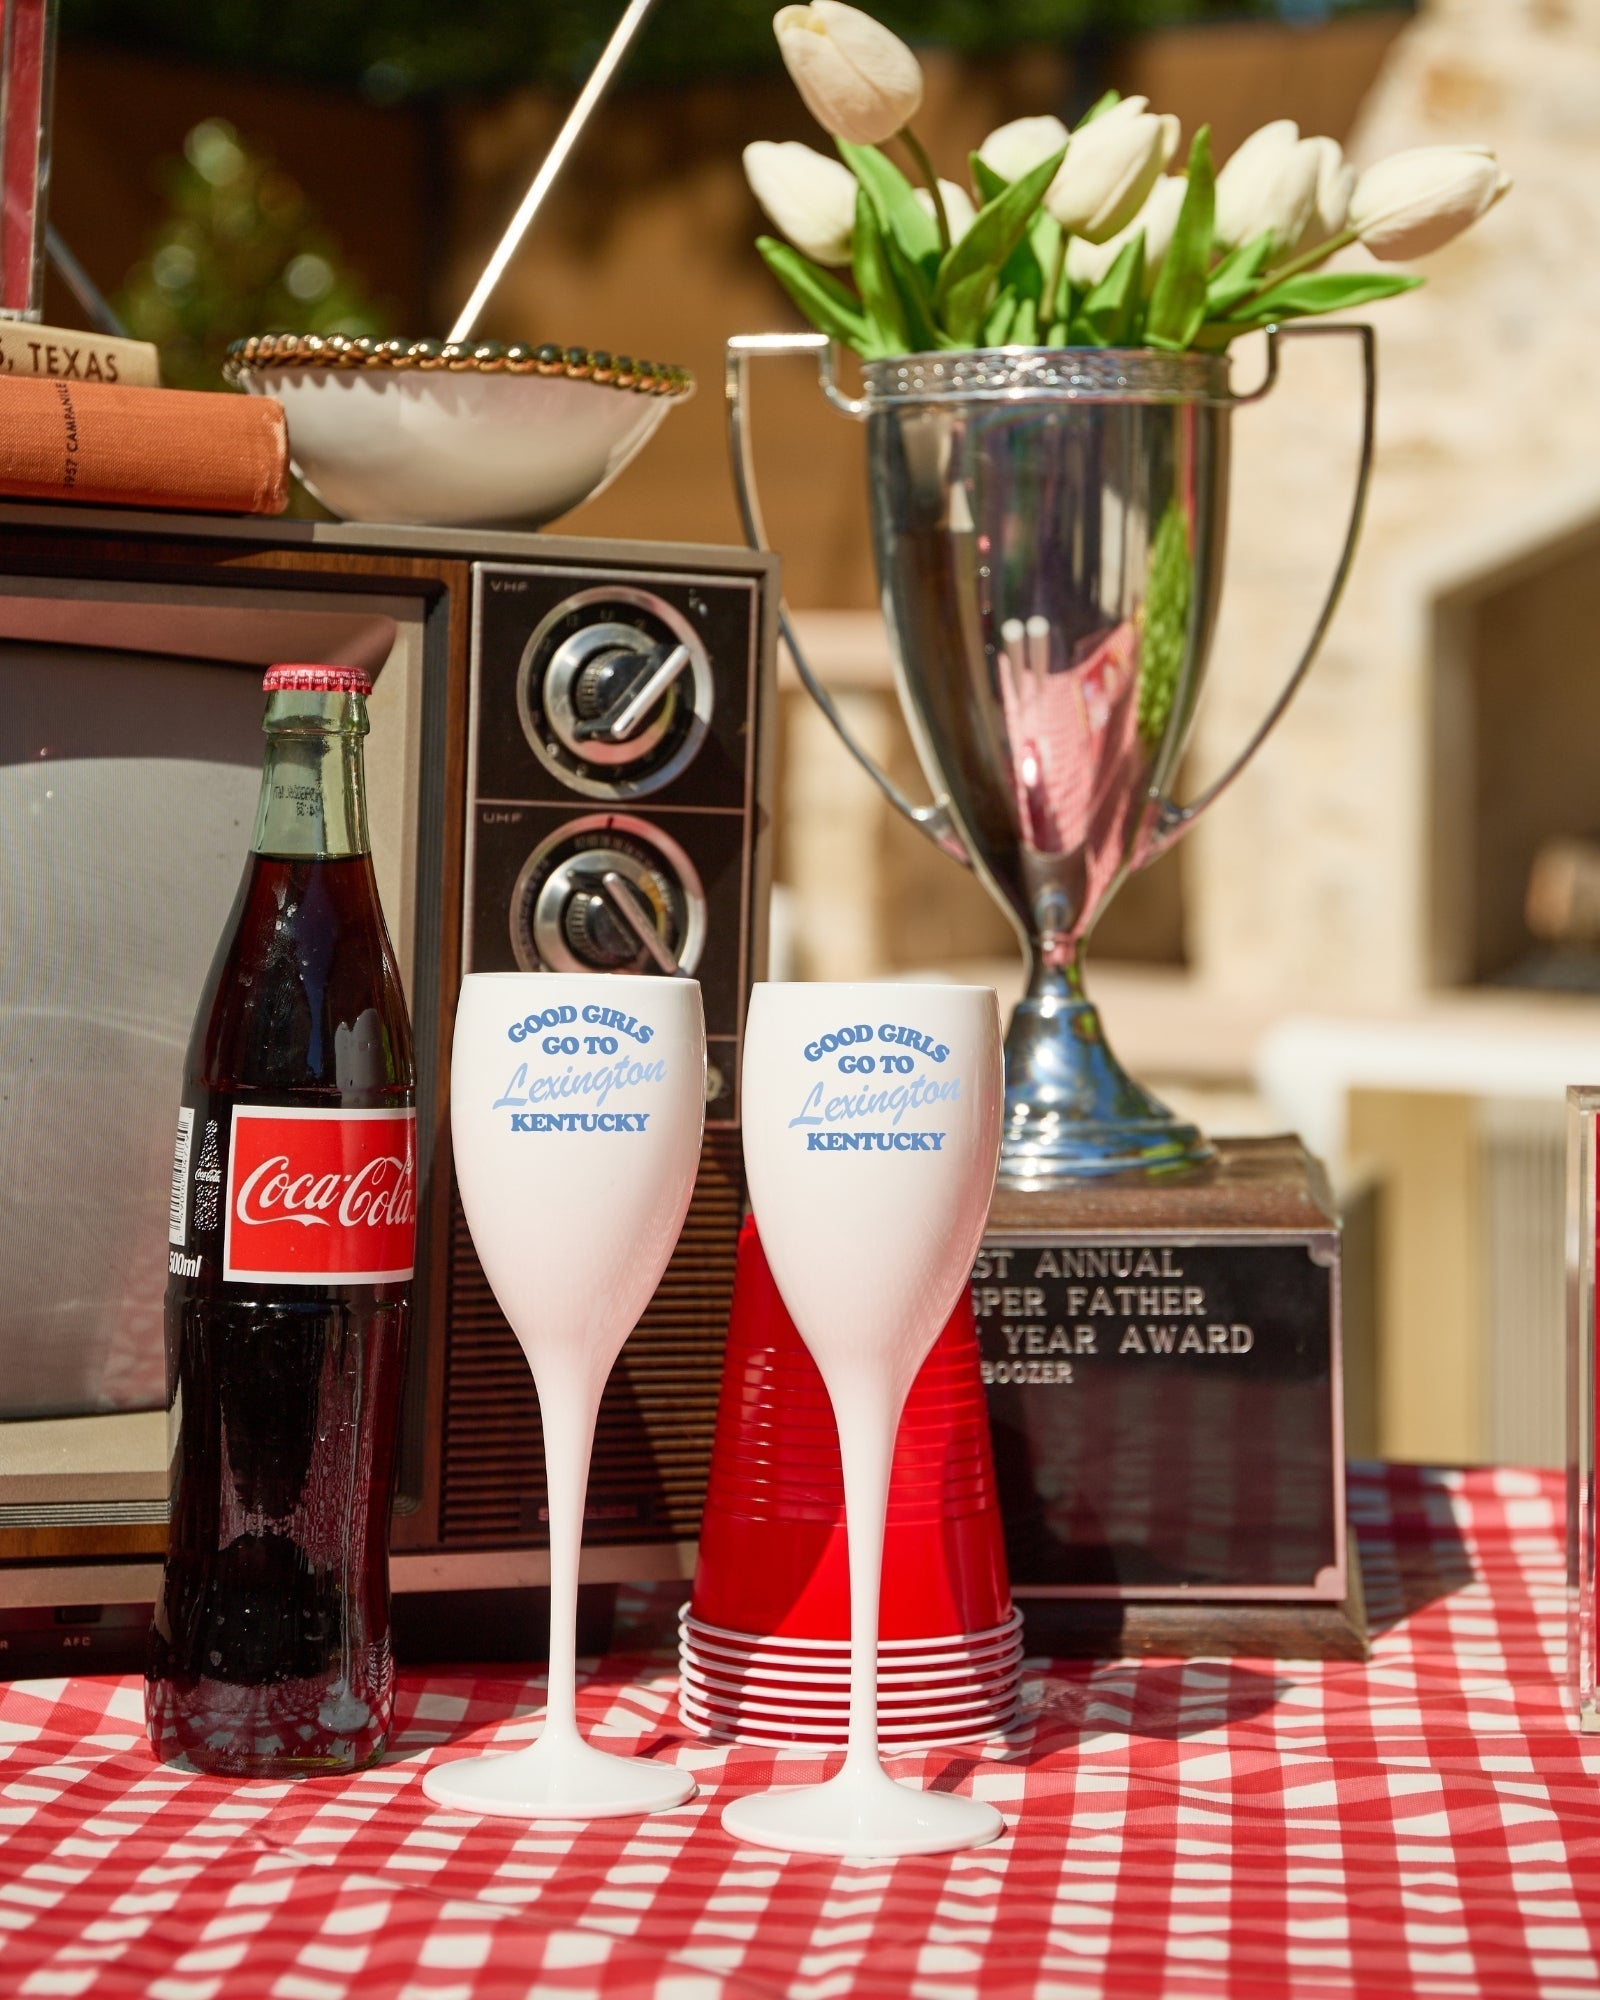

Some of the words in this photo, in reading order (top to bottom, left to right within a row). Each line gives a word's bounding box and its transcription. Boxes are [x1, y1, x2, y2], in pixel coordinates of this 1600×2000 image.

[27, 341, 118, 382] TEXAS
[56, 383, 78, 452] CAMPANILE
[490, 580, 529, 592] VHF
[483, 812, 522, 824] UHF
[508, 1005, 578, 1043] GOOD
[582, 1005, 654, 1043] GIRLS
[542, 1036, 580, 1055] GO
[583, 1036, 619, 1055] TO
[804, 1024, 873, 1062] GOOD
[878, 1023, 950, 1063] GIRLS
[838, 1055, 876, 1074] GO
[879, 1055, 914, 1074] TO
[492, 1055, 667, 1110] Lexington
[788, 1074, 963, 1128] Lexington
[511, 1113, 650, 1132] KENTUCKY
[806, 1132, 946, 1151] KENTUCKY
[236, 1155, 414, 1227] Coca-Cola
[168, 1251, 203, 1278] 500ml
[1034, 1248, 1184, 1279] ANNUAL
[1066, 1285, 1207, 1317] FATHER
[1000, 1324, 1099, 1355] YEAR
[1118, 1323, 1255, 1355] AWARD
[63, 1636, 91, 1648] AFC
